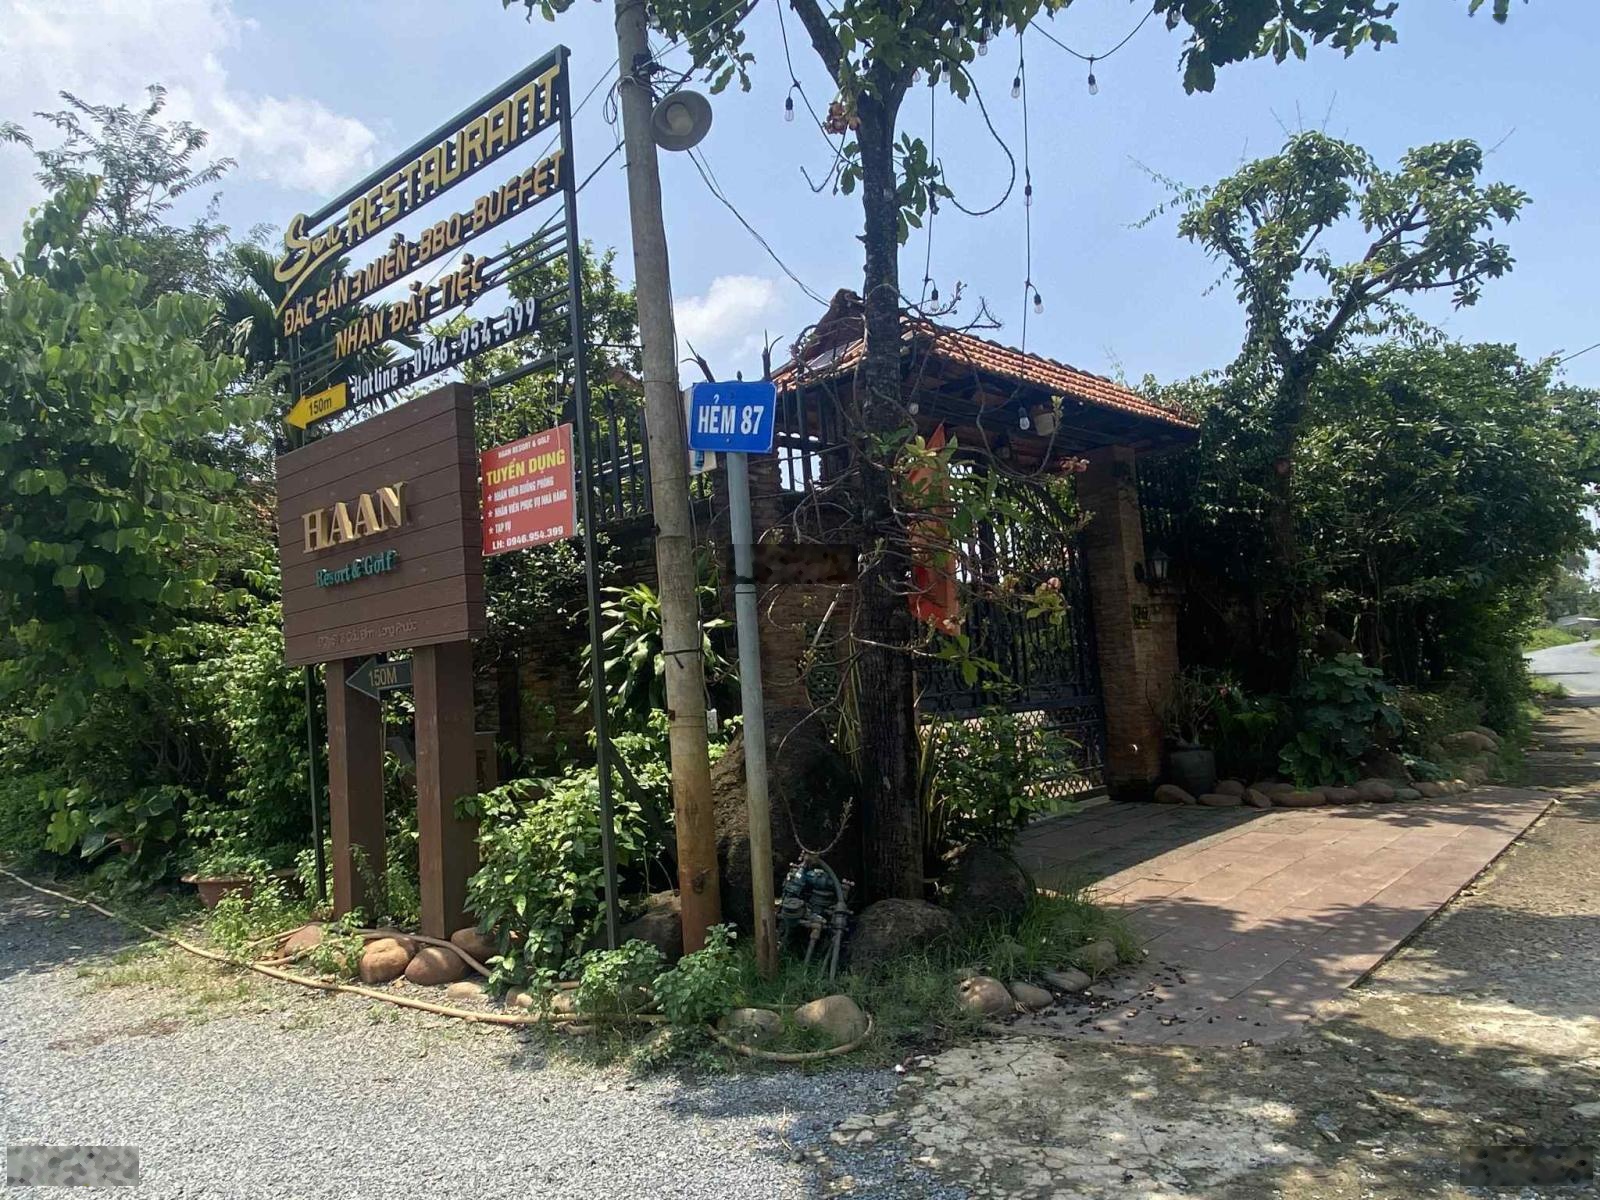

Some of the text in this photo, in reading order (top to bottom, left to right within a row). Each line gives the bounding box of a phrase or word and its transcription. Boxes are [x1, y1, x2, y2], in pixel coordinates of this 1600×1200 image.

[347, 64, 560, 243] RESTAURANT
[316, 269, 348, 319] SẢN
[335, 253, 485, 360] NHẬN ĐẶT TIỆC
[308, 397, 332, 417] 150m
[698, 394, 764, 434] HẺM 87
[486, 458, 525, 486] TUYỂN
[302, 481, 406, 553] HAAN
[506, 525, 564, 547] 0946.954.399
[315, 563, 350, 588] Resort
[363, 550, 398, 576] Golf
[369, 667, 397, 686] 150M
